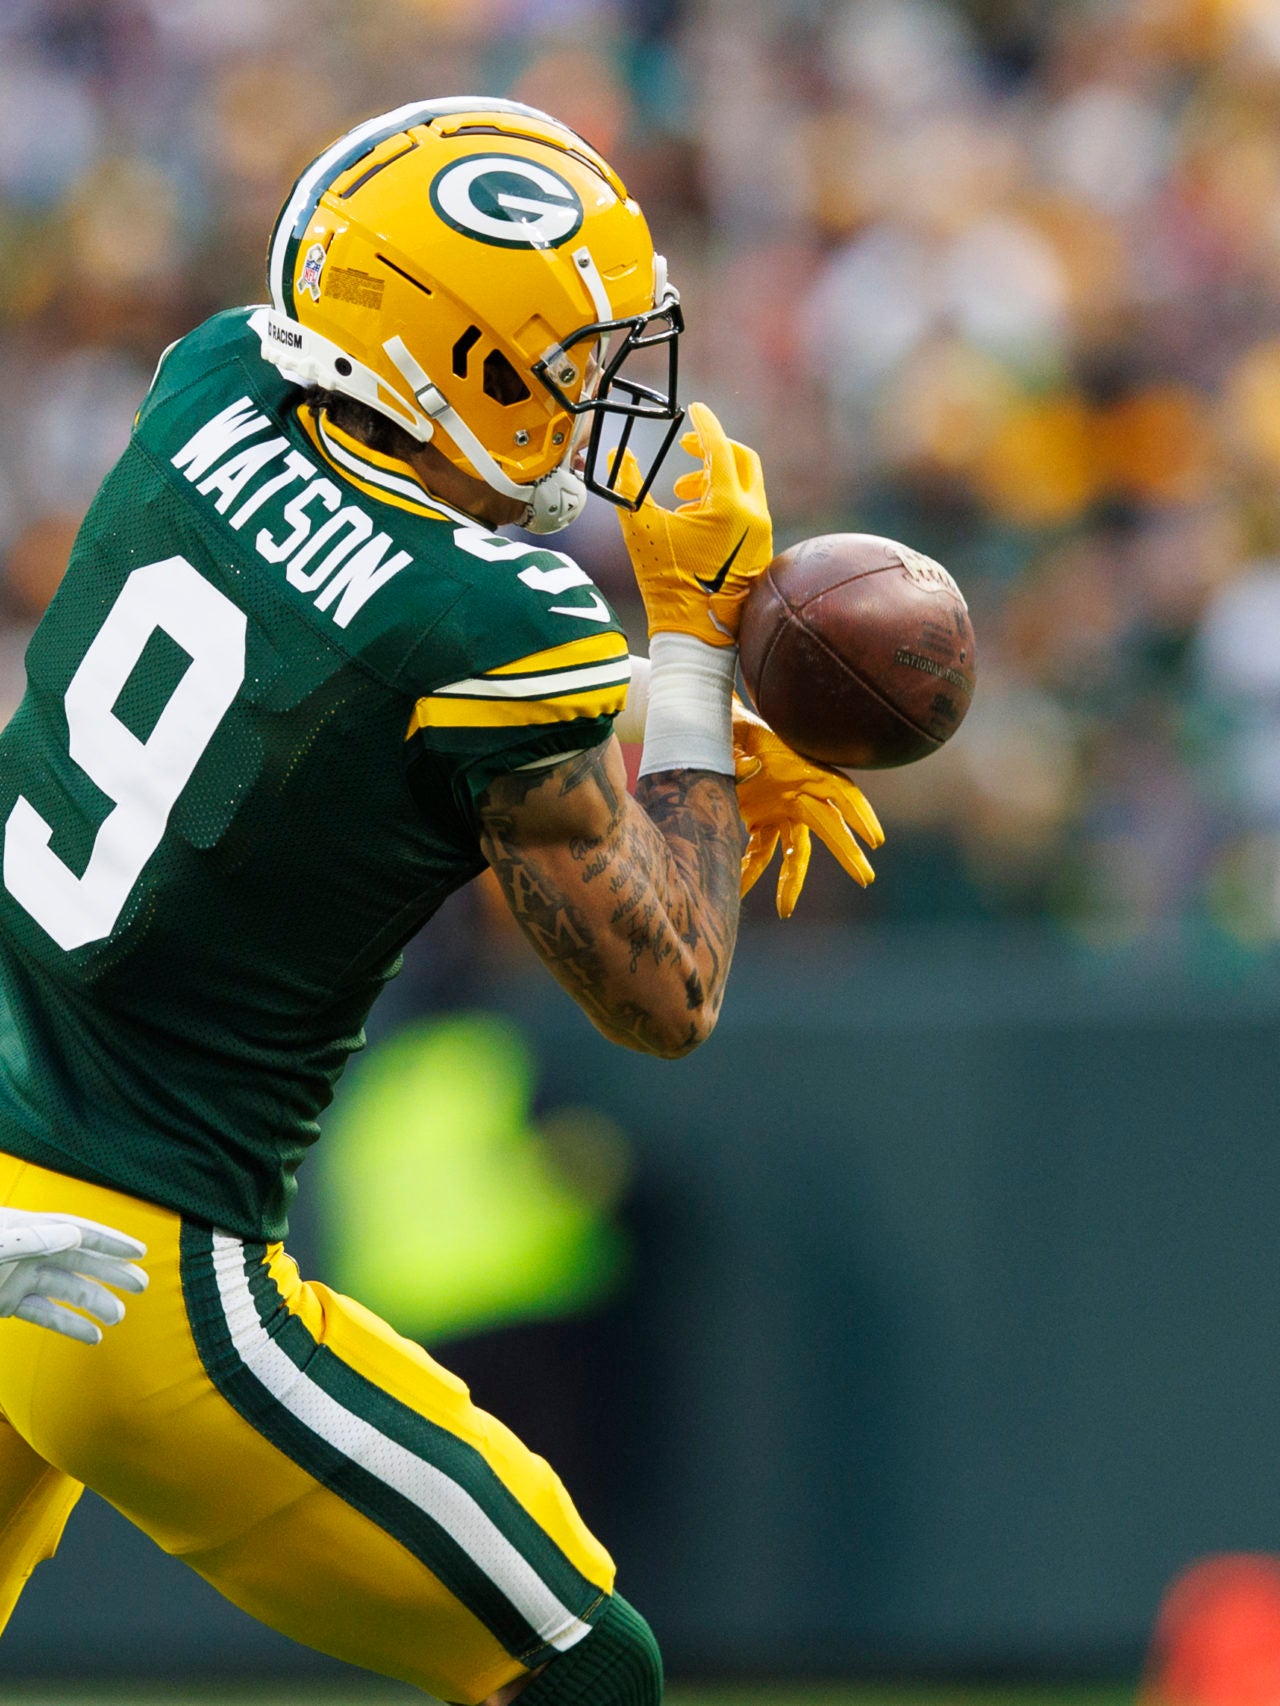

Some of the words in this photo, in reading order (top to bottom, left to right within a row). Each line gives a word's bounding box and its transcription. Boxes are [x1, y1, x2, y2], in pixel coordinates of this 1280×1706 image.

[436, 156, 580, 243] G
[272, 324, 303, 350] RACISM
[170, 395, 414, 630] WATSON
[452, 526, 594, 595] 9
[894, 648, 944, 680] NATIONAL
[2, 554, 249, 953] 9
